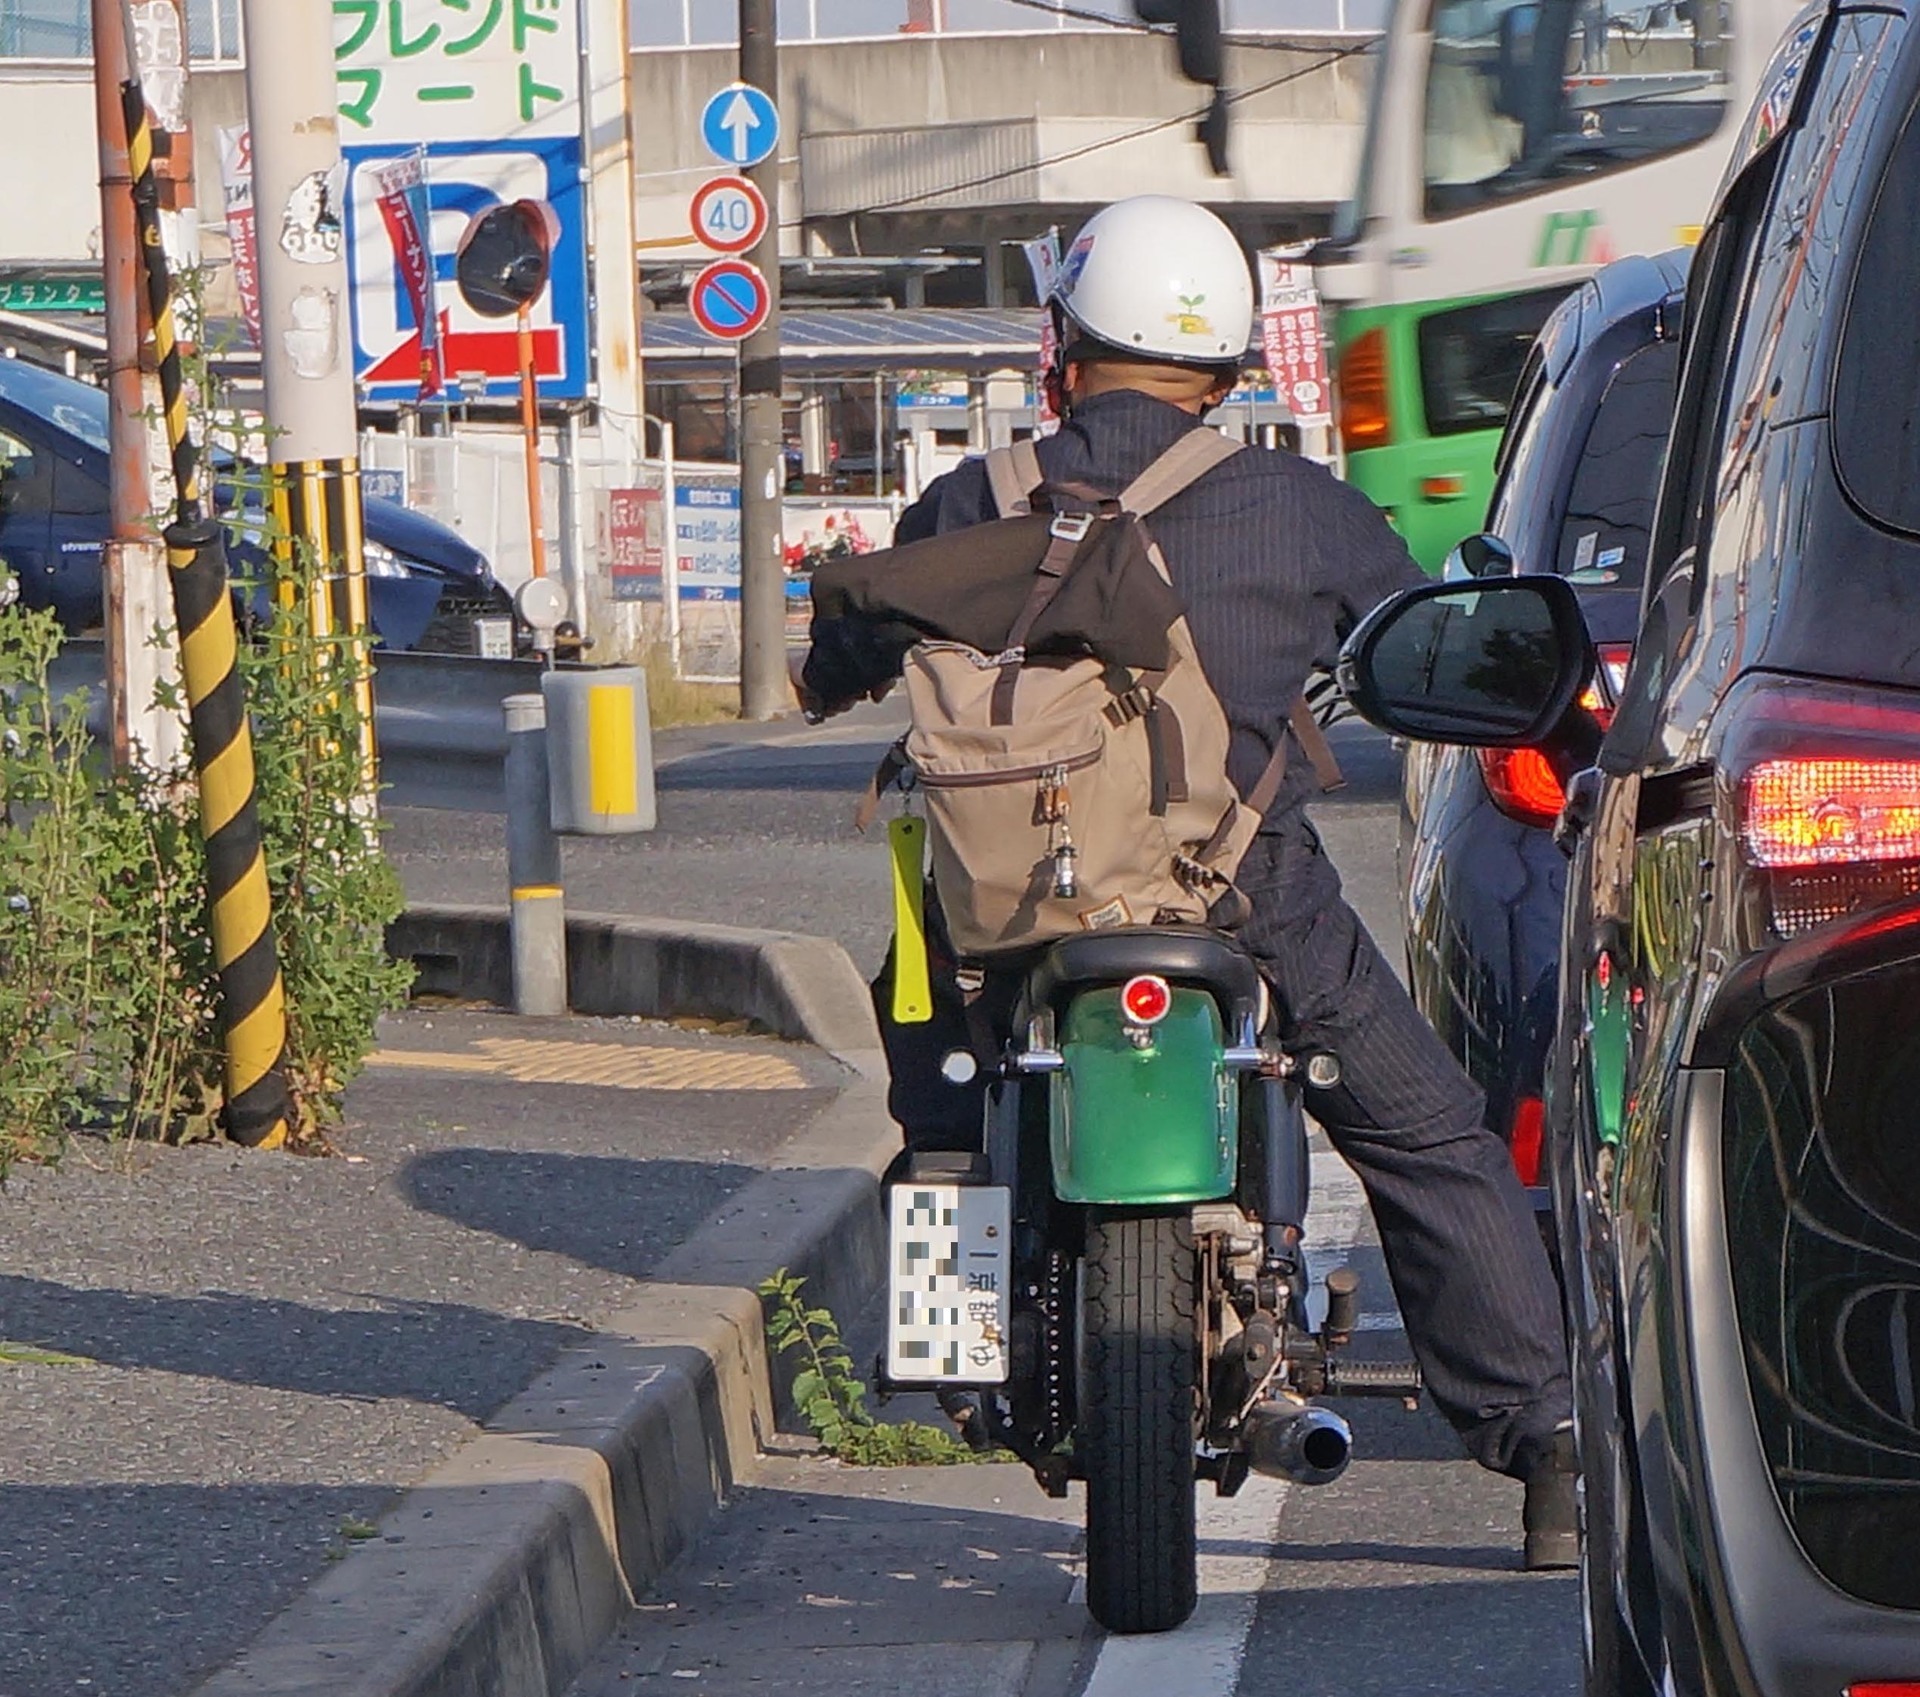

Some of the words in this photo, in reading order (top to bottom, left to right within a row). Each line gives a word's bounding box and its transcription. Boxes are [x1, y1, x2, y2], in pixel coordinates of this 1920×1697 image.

[333, 0, 559, 60] フレンド
[337, 62, 564, 128] マート
[709, 199, 749, 231] 40
